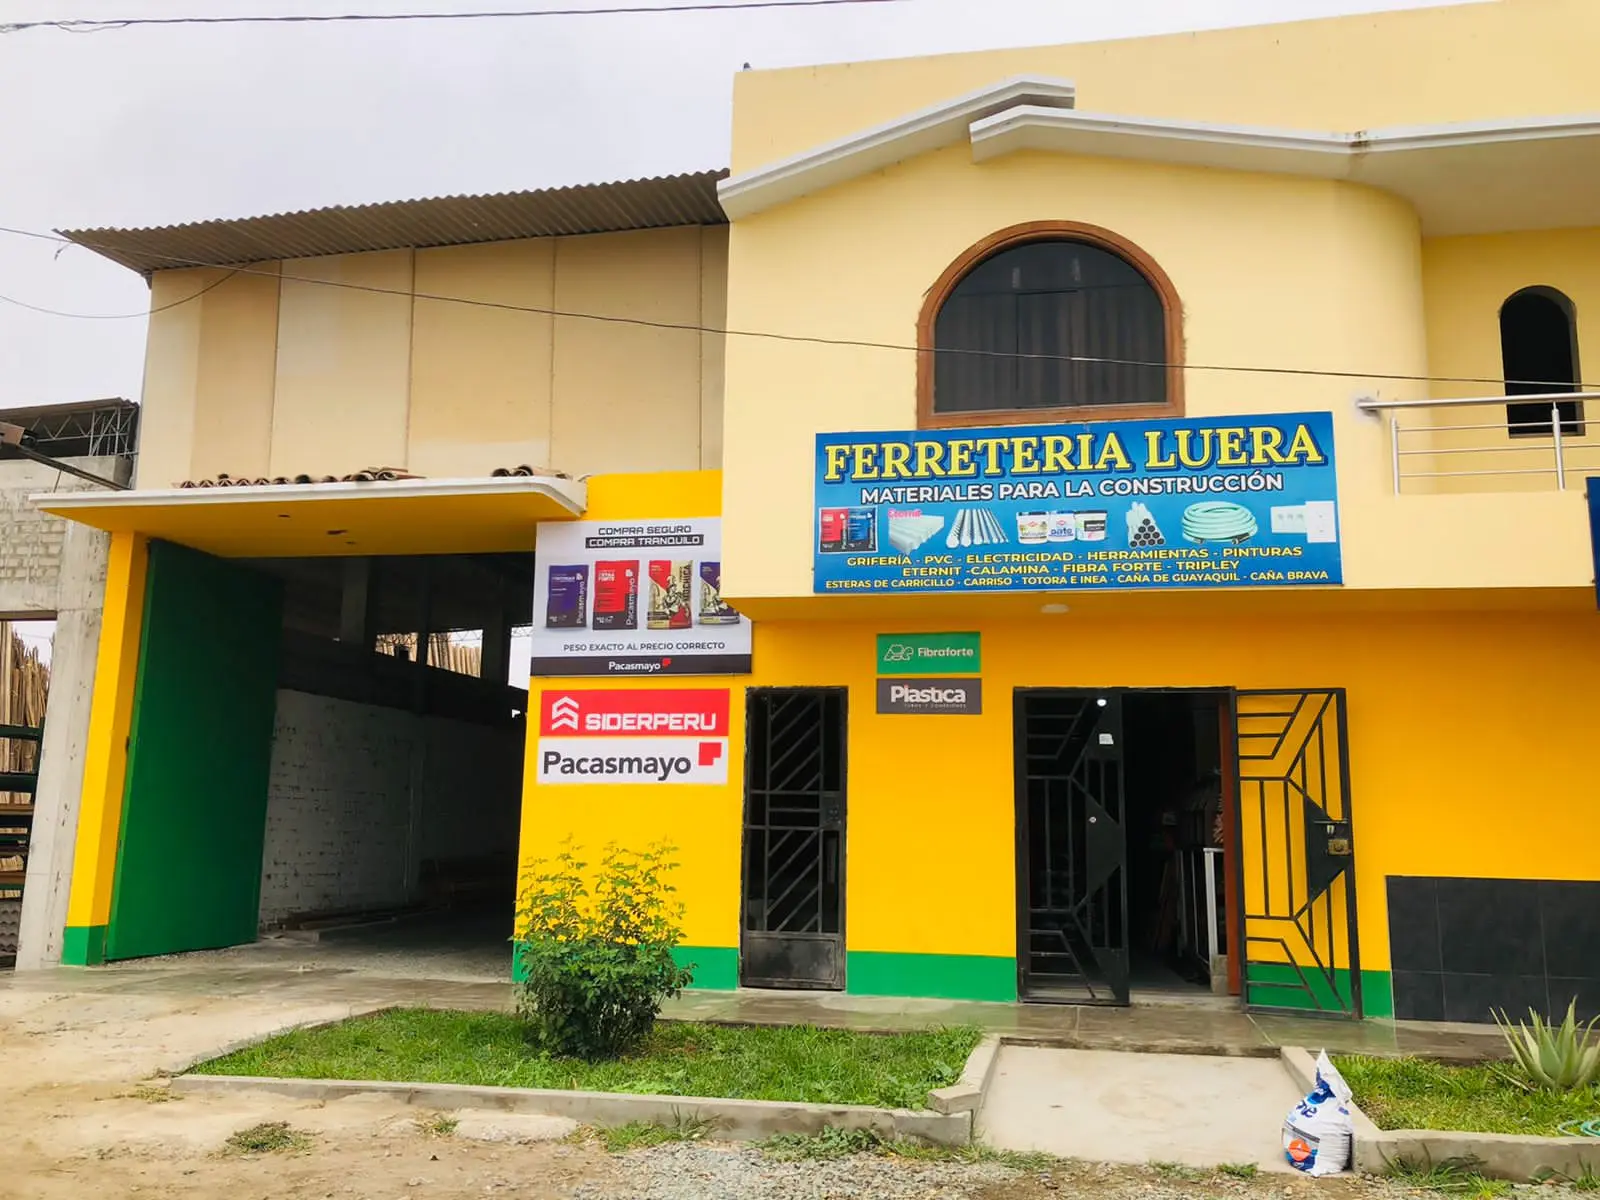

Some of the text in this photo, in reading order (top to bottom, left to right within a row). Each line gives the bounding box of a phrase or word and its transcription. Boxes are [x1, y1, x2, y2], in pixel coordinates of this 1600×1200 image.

[823, 423, 1326, 482] FERRETERIA LUERA
[861, 471, 1284, 504] MATERIALES PARA LA CONSTRUCCIÓN
[598, 525, 692, 536] COMPRA SEGURO
[589, 535, 701, 547] COMPRA TRANQUILO
[847, 546, 1303, 566] GRIFERÍA PVC ELECTRICIDAD HERRAMIENTAS PINTURAS
[902, 566, 962, 577] ETERNIT
[1063, 563, 1108, 573] FIBRA
[1112, 561, 1162, 572] FORTE
[1175, 560, 1240, 571] TRIPLEY
[825, 570, 1328, 589] ESTERAS DE CARRICILLO CARRISO TOTORA E INEA CAÑA DE GUAYAQUIL CAÑA BRAVA
[563, 641, 725, 652] PESO EXACTO AL PRECIO CORRECTO
[918, 647, 974, 657] Fibraforte
[608, 660, 661, 673] Pacasmayo
[585, 713, 716, 731] SIDERPERU
[542, 751, 692, 781] Pacasmayo
